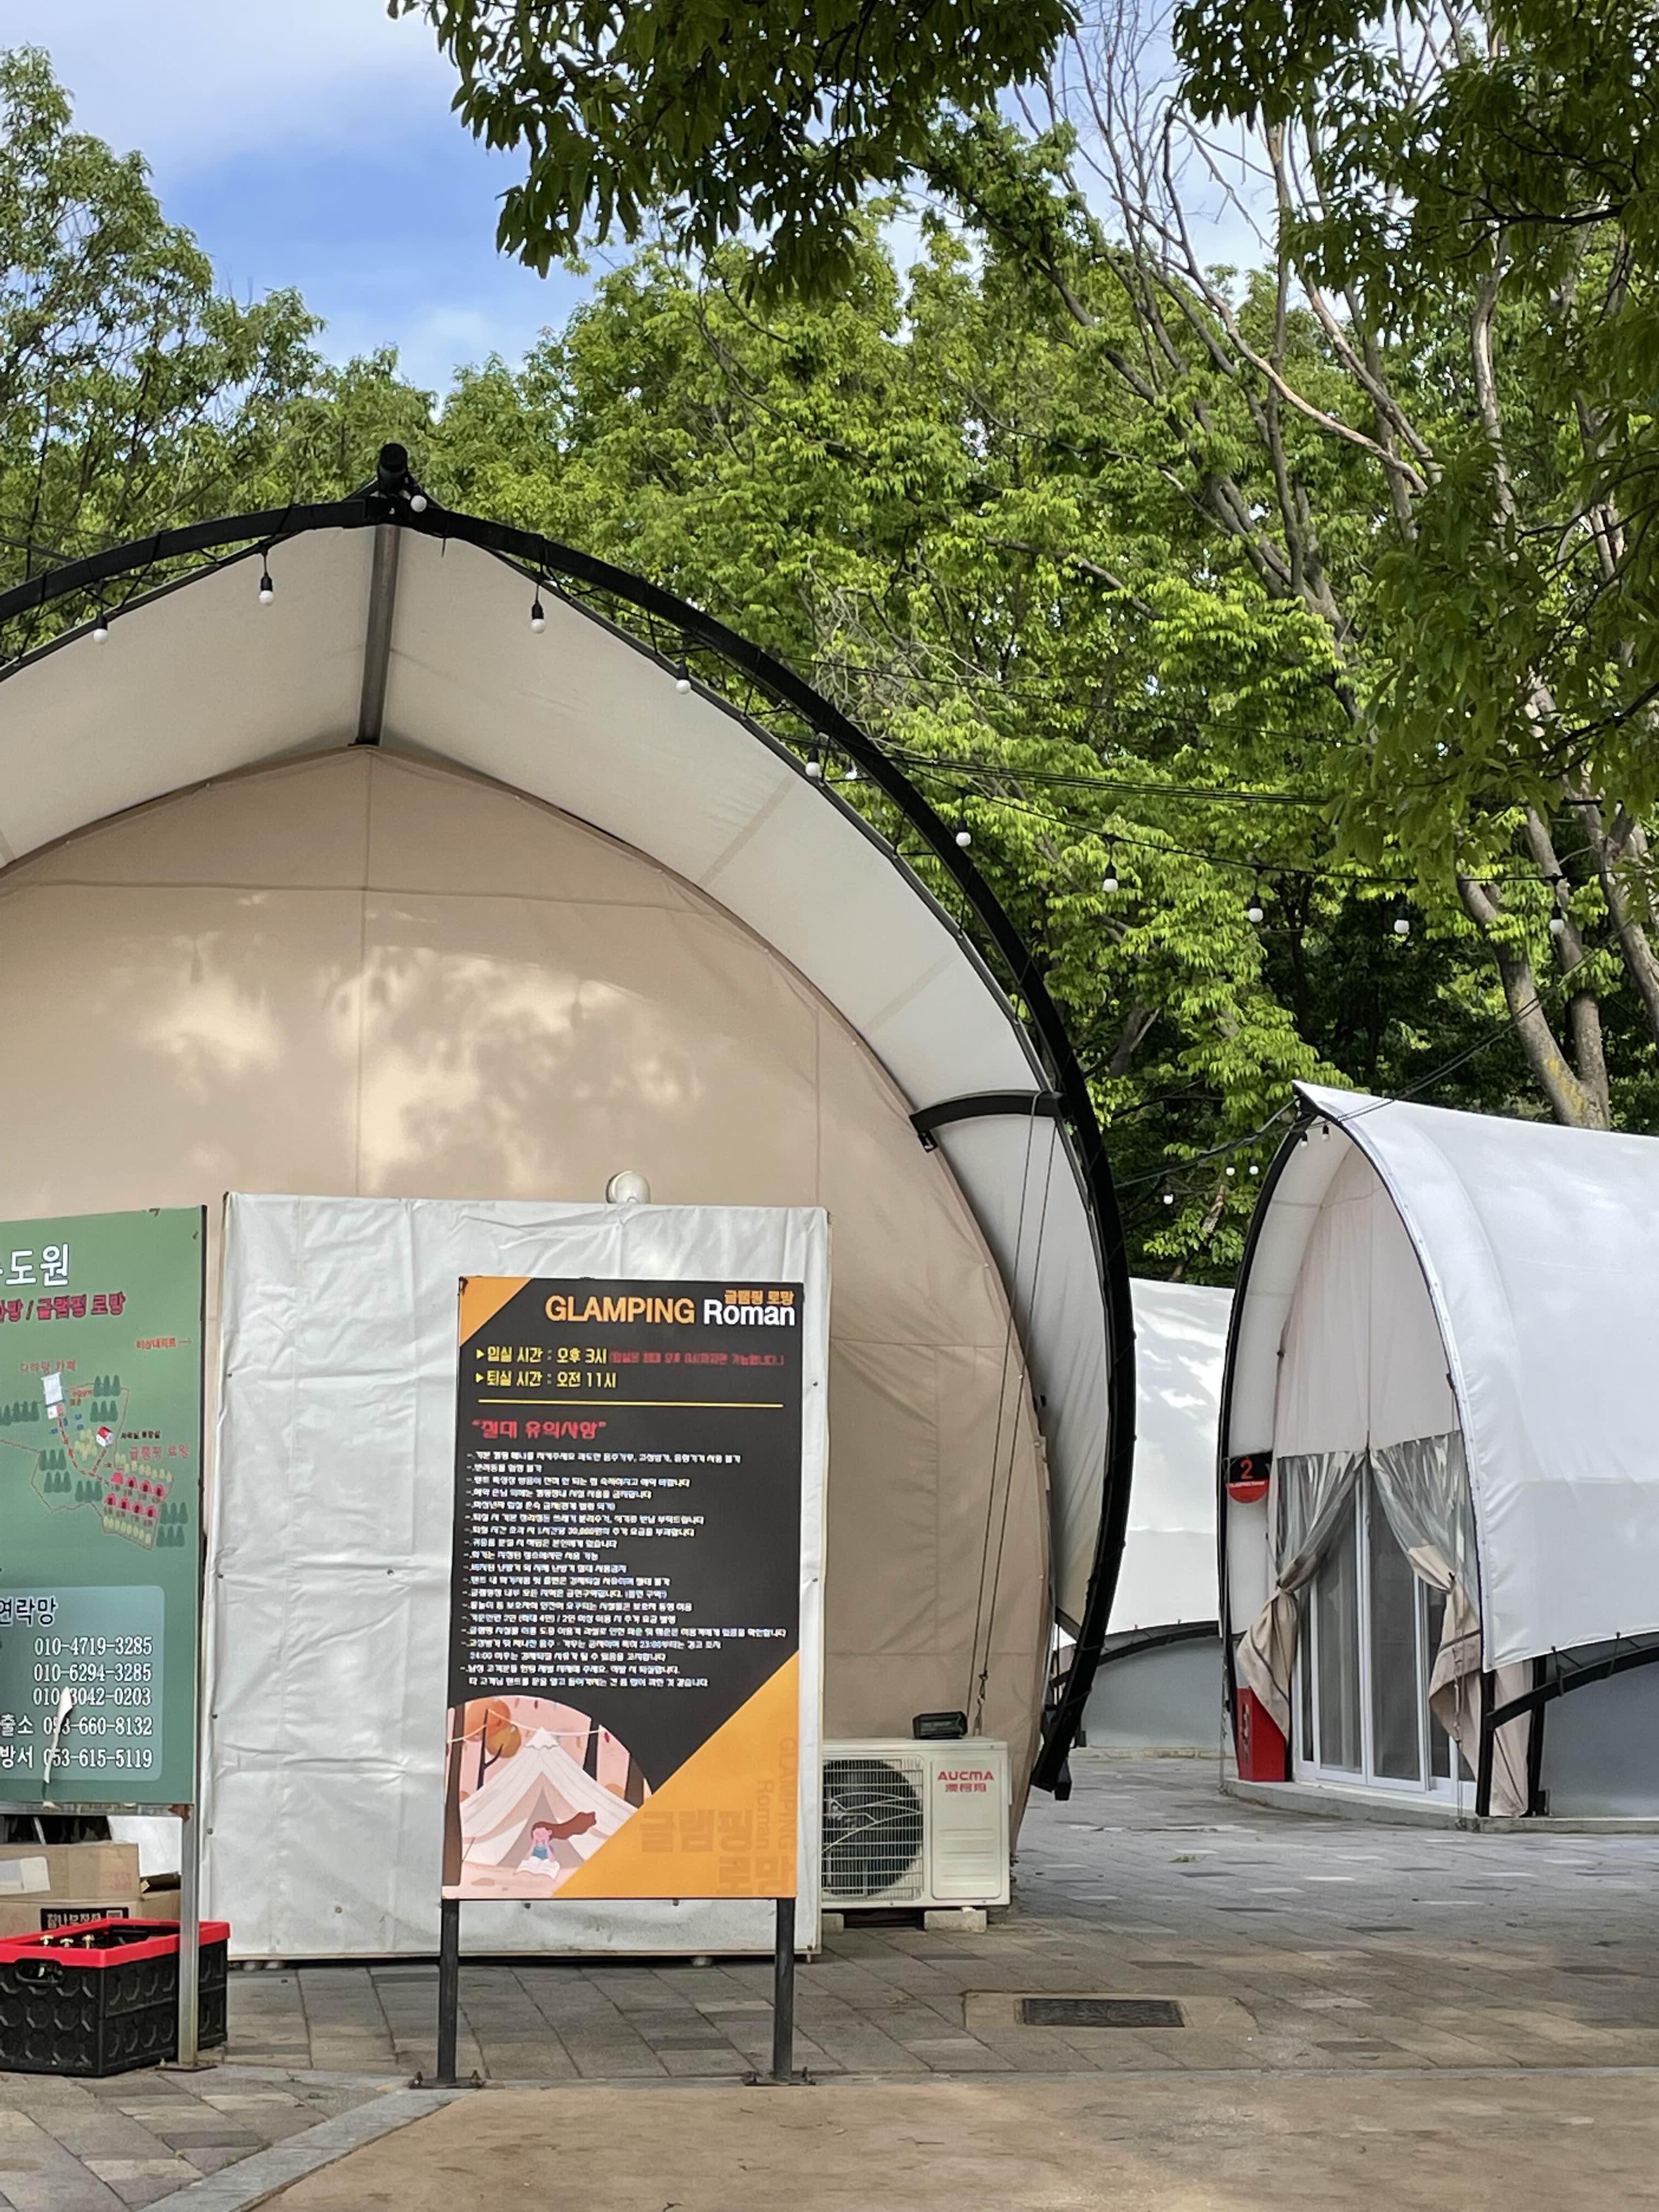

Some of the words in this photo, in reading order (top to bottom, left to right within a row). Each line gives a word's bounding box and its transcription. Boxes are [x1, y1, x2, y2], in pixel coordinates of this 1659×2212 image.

[0, 1242, 70, 1287] 도원
[545, 1295, 695, 1324] GLAMPING
[704, 1299, 795, 1327] Roman
[487, 1346, 512, 1362] 입실
[517, 1347, 543, 1363] 시간
[556, 1347, 581, 1363] 오후
[585, 1347, 607, 1364] 3시
[487, 1370, 512, 1386] 퇴실
[516, 1371, 543, 1387] 시간
[556, 1371, 581, 1387] 오전
[586, 1372, 617, 1389] 11시
[1240, 1458, 1255, 1480] 2
[0, 1595, 58, 1628] 연락망
[34, 1636, 153, 1656] 010-4719-3285
[33, 1662, 153, 1683] 010-6294-3285
[32, 1687, 152, 1707] 0103042-0203
[938, 1770, 995, 1781] AUCMA
